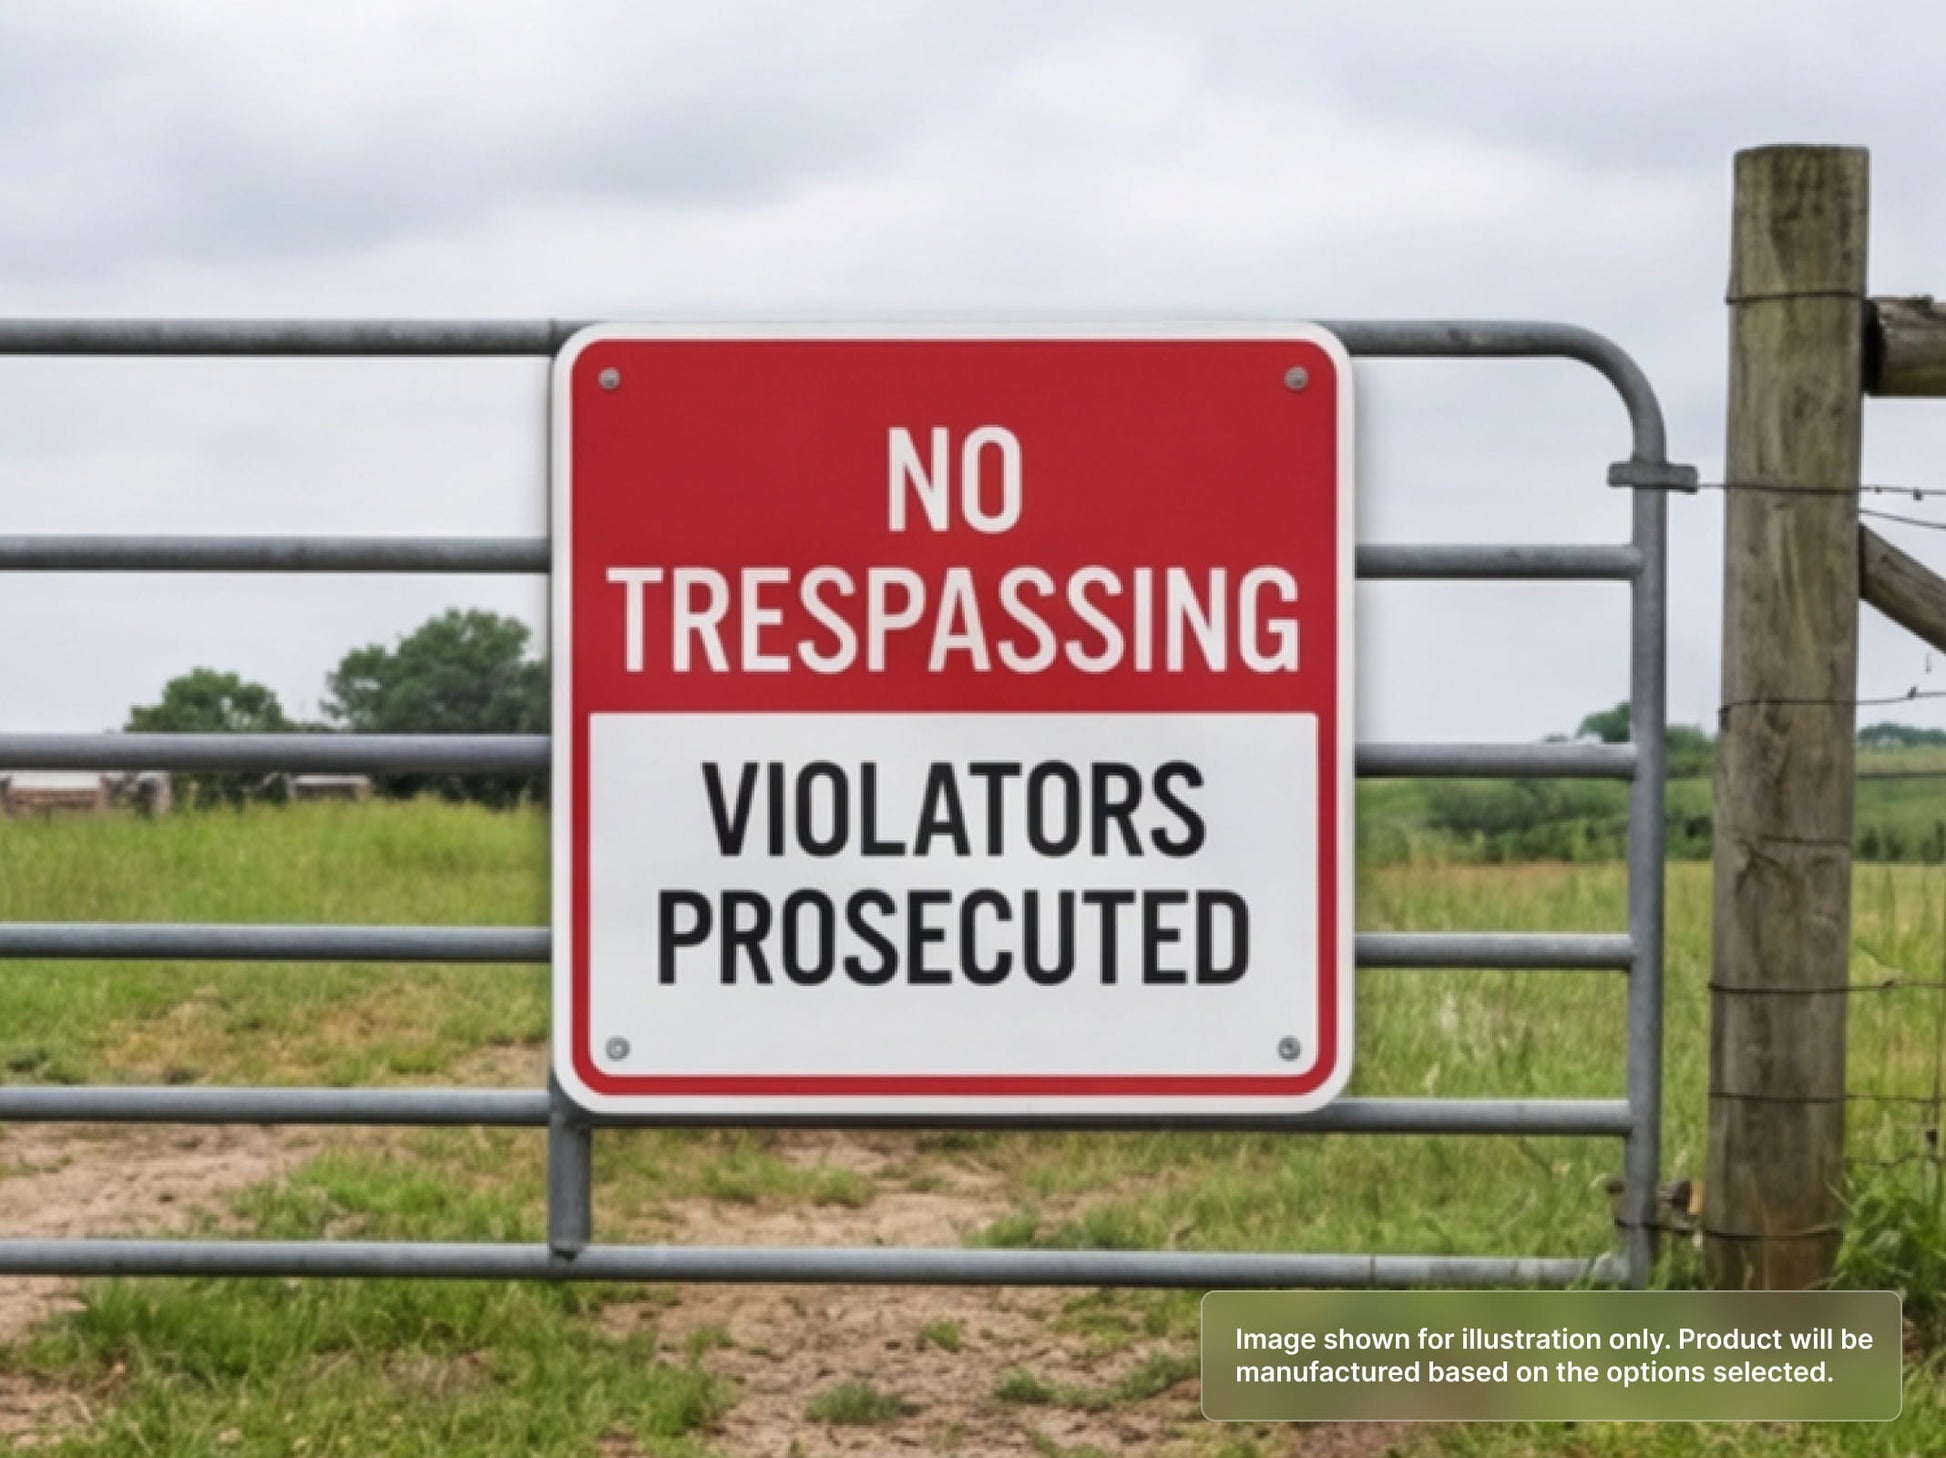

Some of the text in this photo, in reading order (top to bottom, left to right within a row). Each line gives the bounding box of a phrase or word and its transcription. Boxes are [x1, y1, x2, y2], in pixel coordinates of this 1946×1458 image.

[889, 426, 1021, 533] NO
[607, 567, 1298, 672] TRESPASSING
[702, 760, 1204, 857] VIOLATORS
[659, 889, 1248, 986] PROSECUTED
